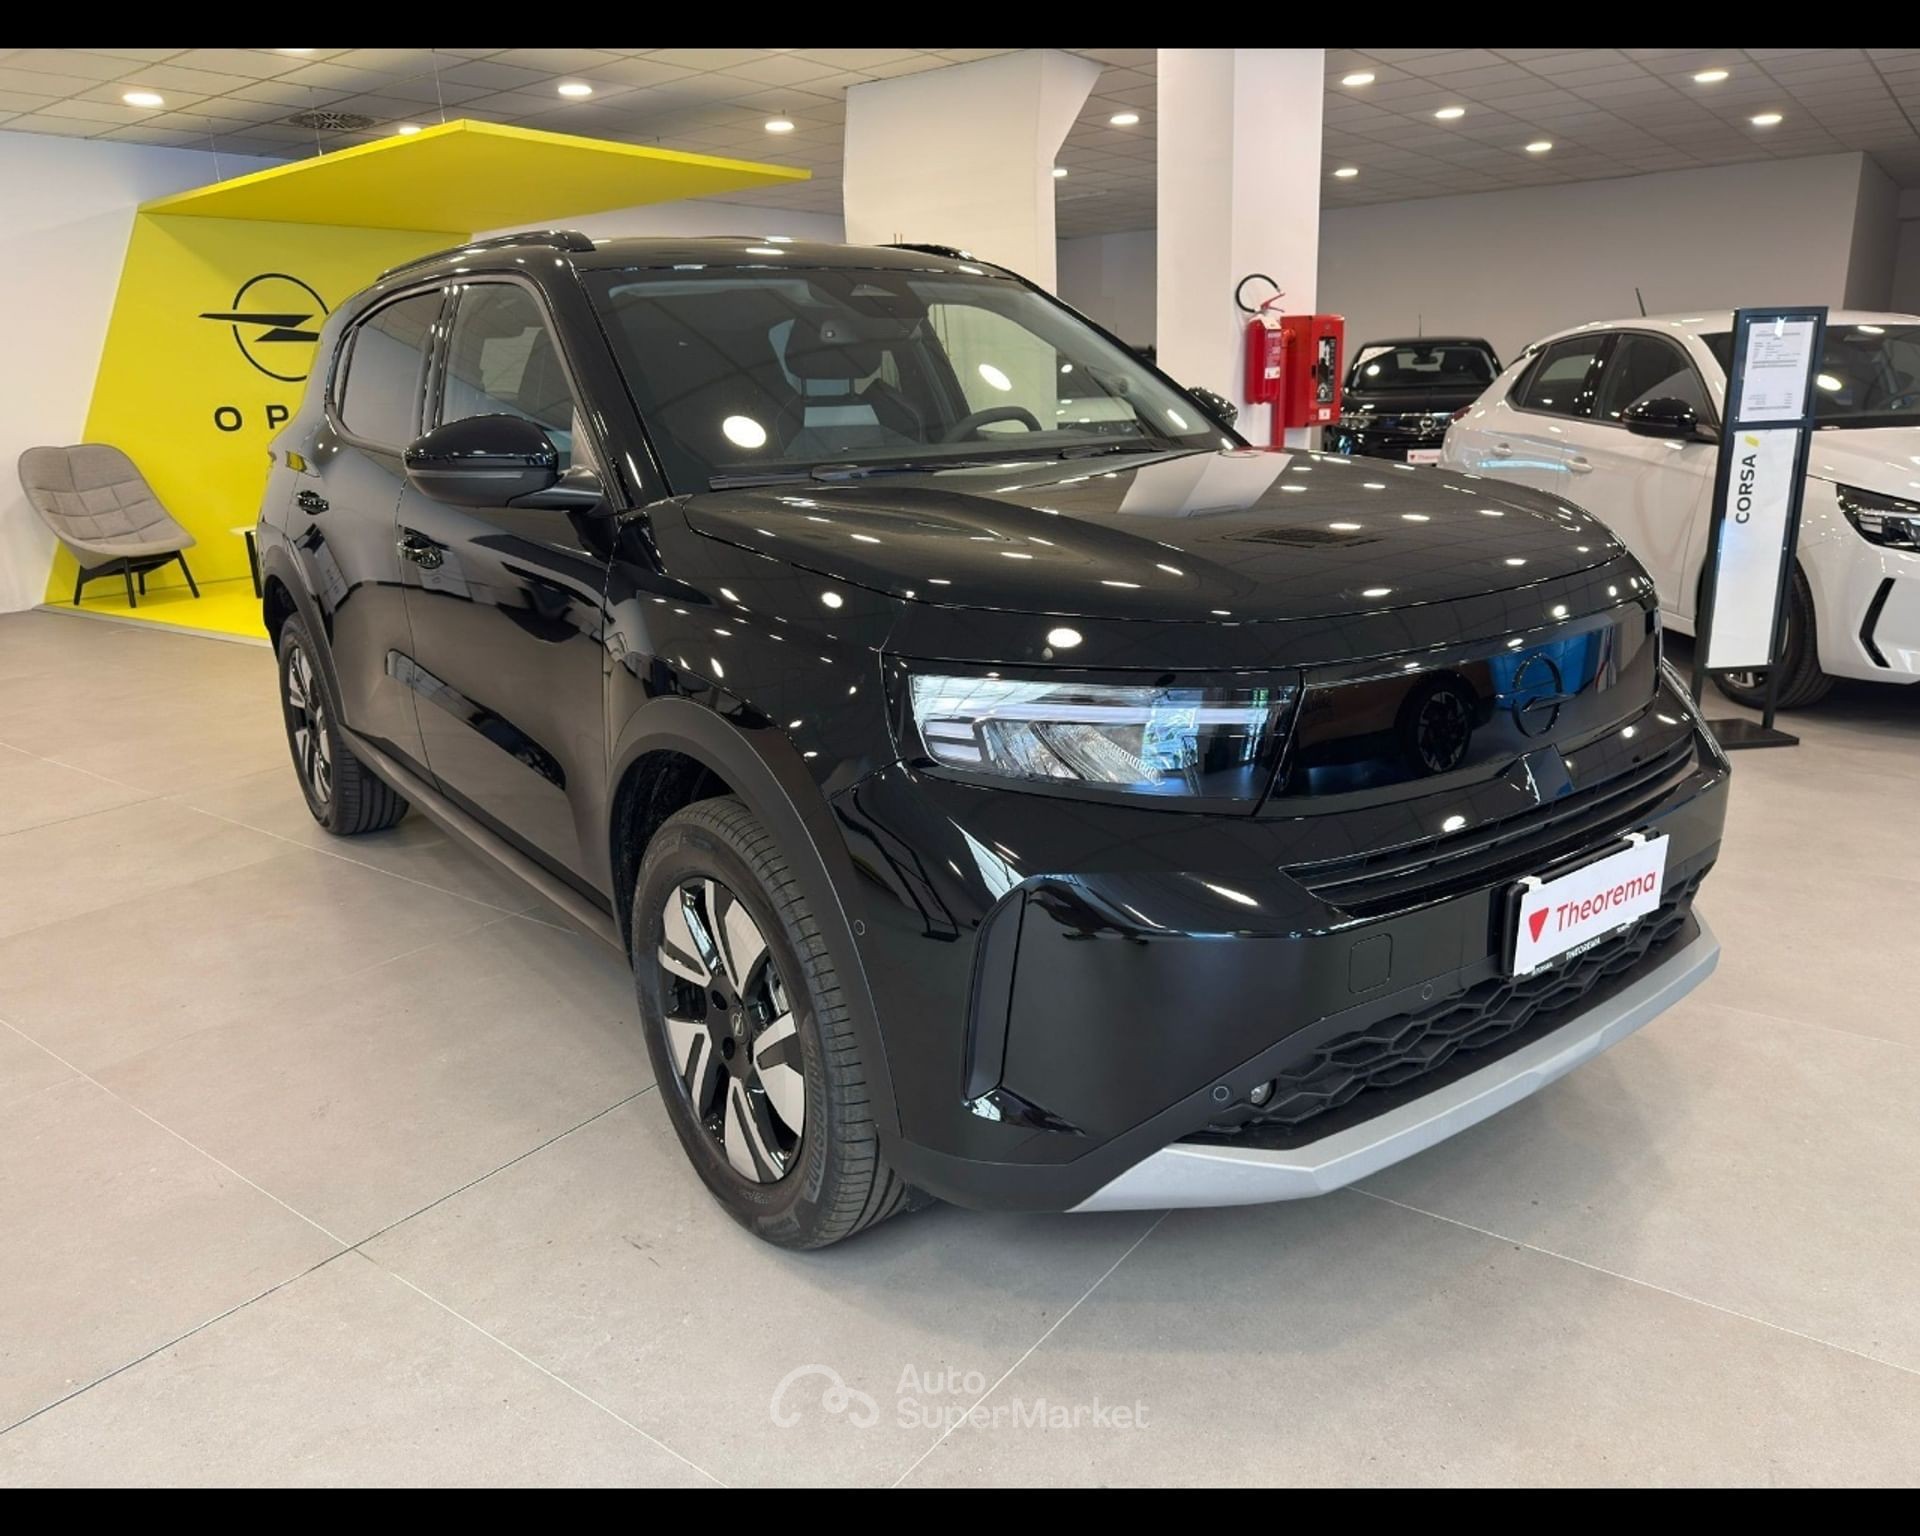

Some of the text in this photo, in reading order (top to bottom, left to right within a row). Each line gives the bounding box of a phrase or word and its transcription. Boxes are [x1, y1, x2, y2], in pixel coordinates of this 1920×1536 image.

[214, 404, 290, 432] OP
[1735, 454, 1757, 524] CORSA
[1556, 871, 1656, 932] Theorema
